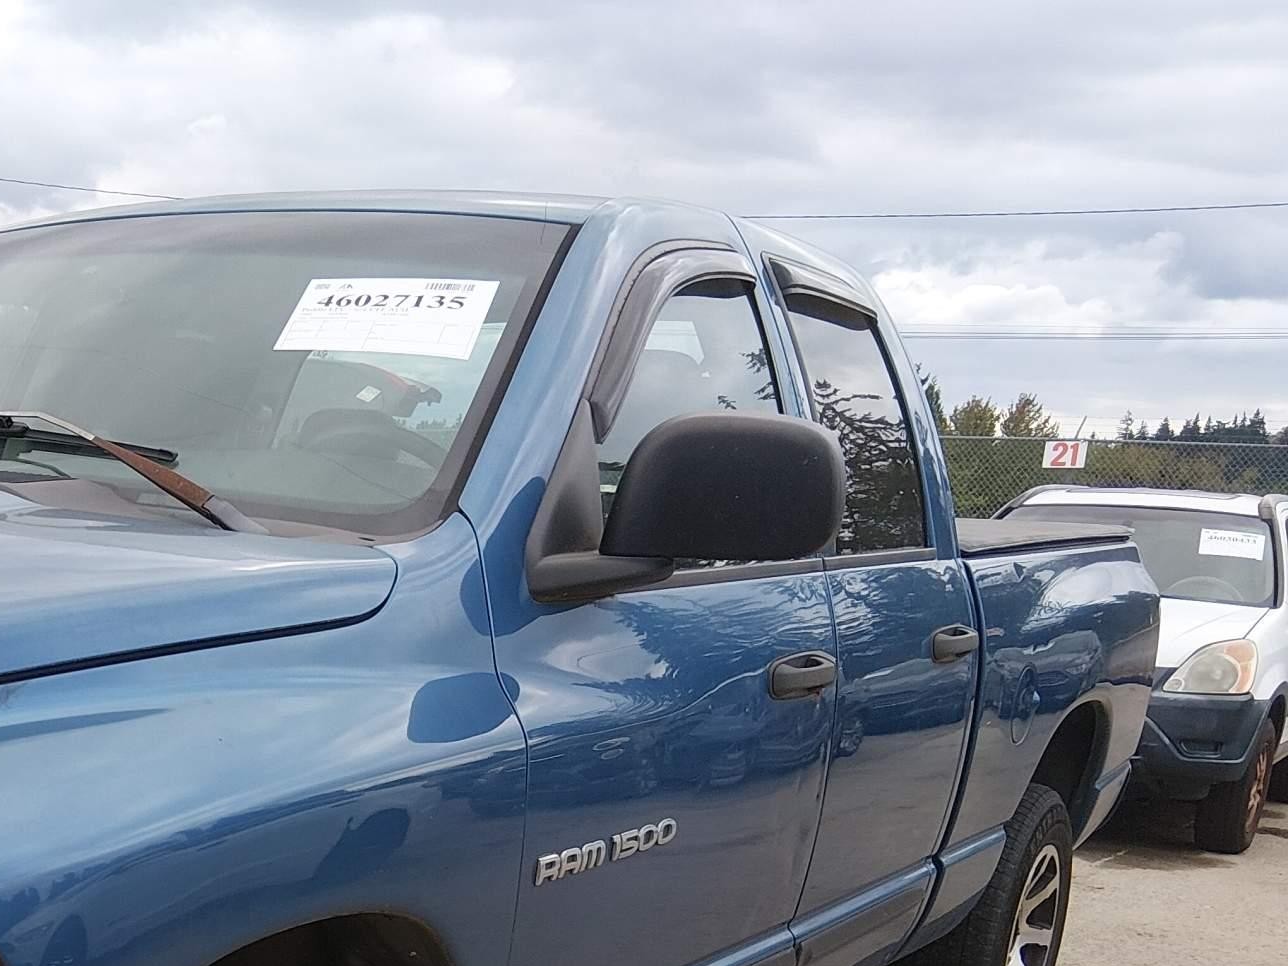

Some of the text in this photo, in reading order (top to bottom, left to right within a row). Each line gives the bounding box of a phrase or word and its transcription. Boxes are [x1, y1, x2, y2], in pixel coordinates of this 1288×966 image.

[316, 293, 468, 311] 46027135
[1050, 442, 1081, 467] 21
[534, 816, 678, 888] RAM 1500
